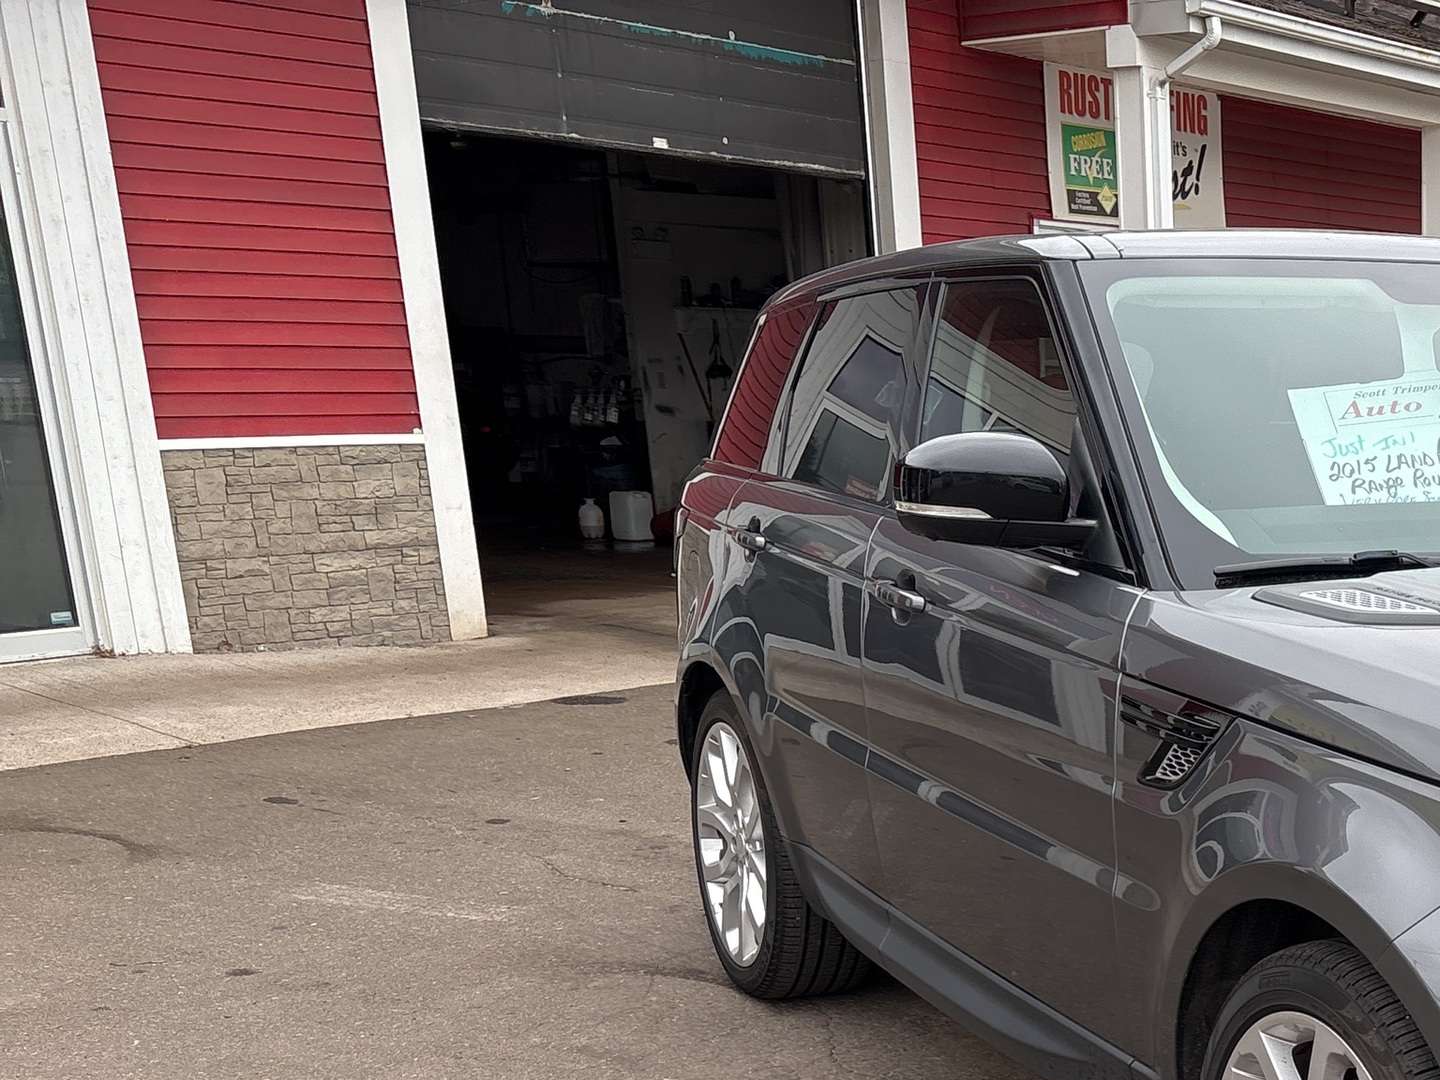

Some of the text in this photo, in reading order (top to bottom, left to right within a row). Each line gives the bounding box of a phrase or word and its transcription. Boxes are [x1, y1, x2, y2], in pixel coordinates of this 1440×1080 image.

[1058, 70, 1208, 136] RUST ING
[1069, 153, 1114, 180] FREE
[1353, 388, 1387, 400] Scott
[1338, 399, 1423, 421] Auto
[1321, 434, 1366, 459] Just
[1328, 455, 1378, 482] 2015
[1385, 451, 1436, 473] LAND
